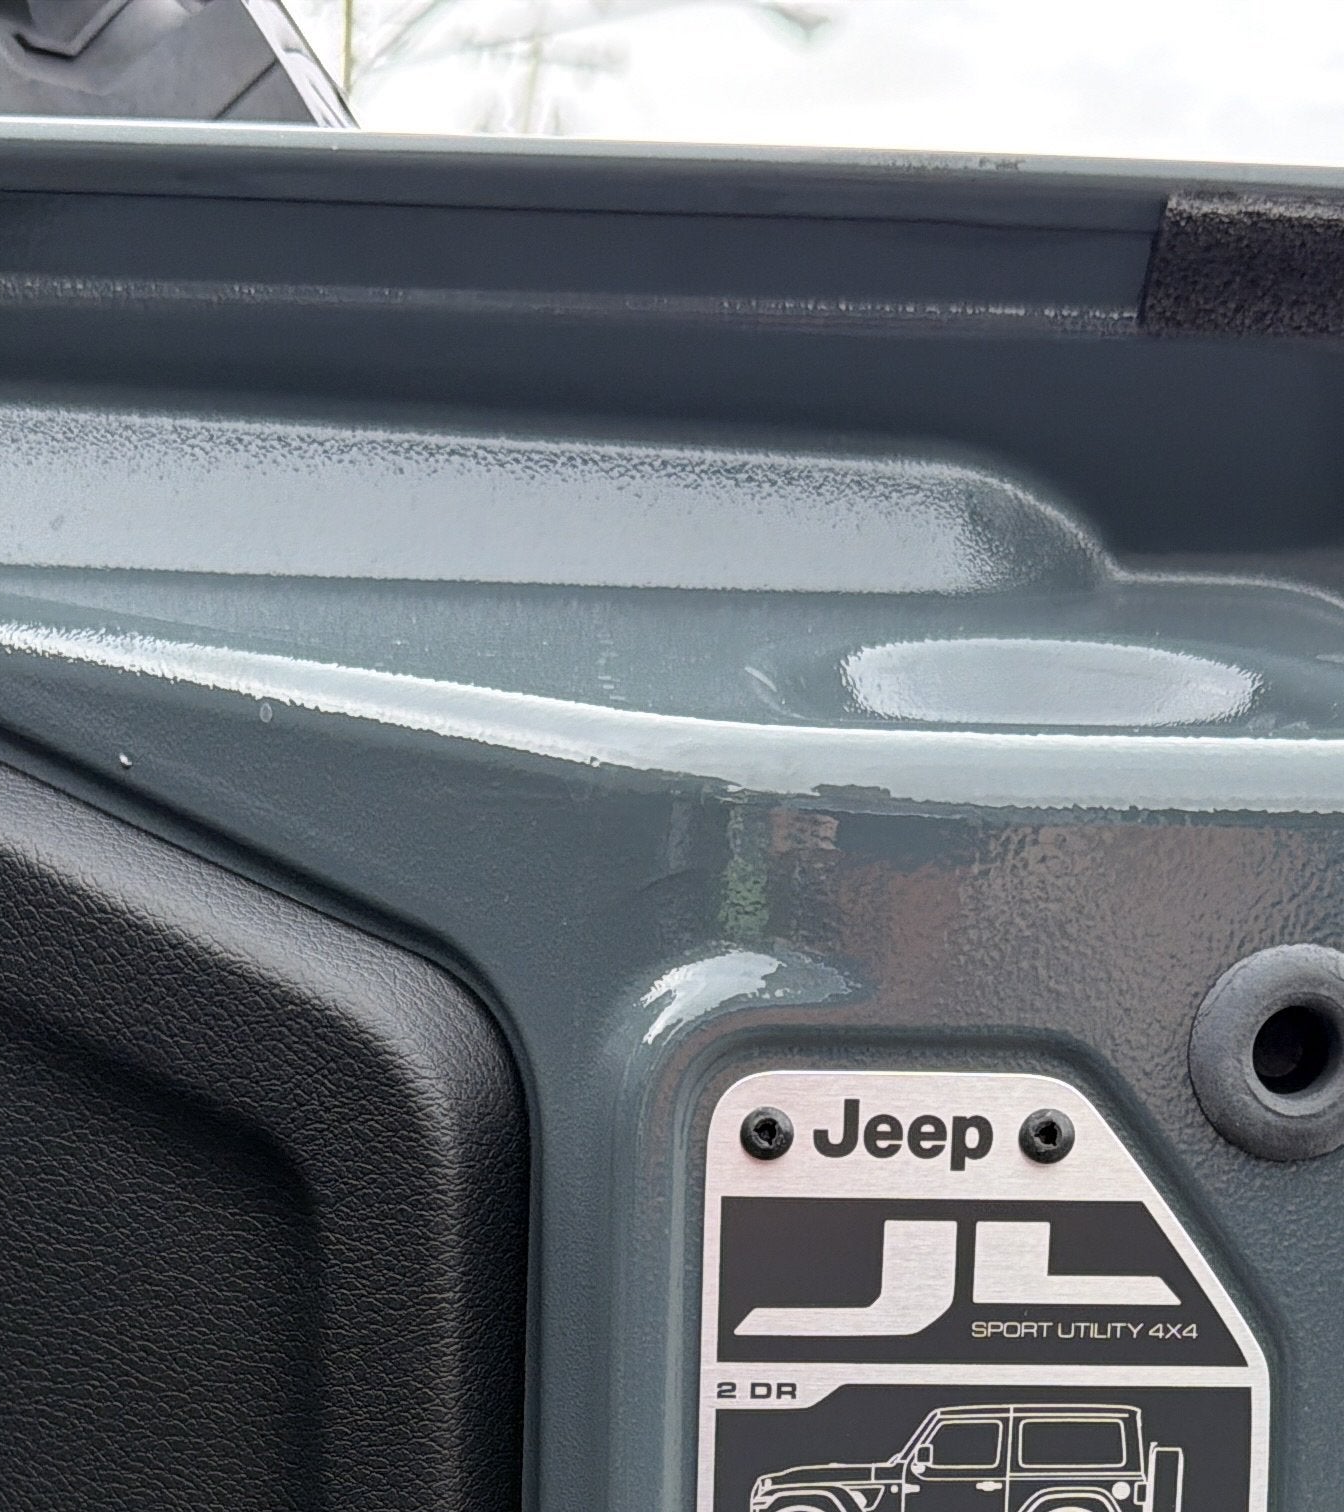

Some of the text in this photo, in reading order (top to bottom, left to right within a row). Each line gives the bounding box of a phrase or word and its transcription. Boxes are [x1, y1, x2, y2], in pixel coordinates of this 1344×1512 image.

[812, 1098, 994, 1172] Jeep
[733, 1218, 1183, 1337] JL
[971, 1321, 1199, 1339] SPORT UTILITY 4X4
[716, 1381, 797, 1400] 2 DR
